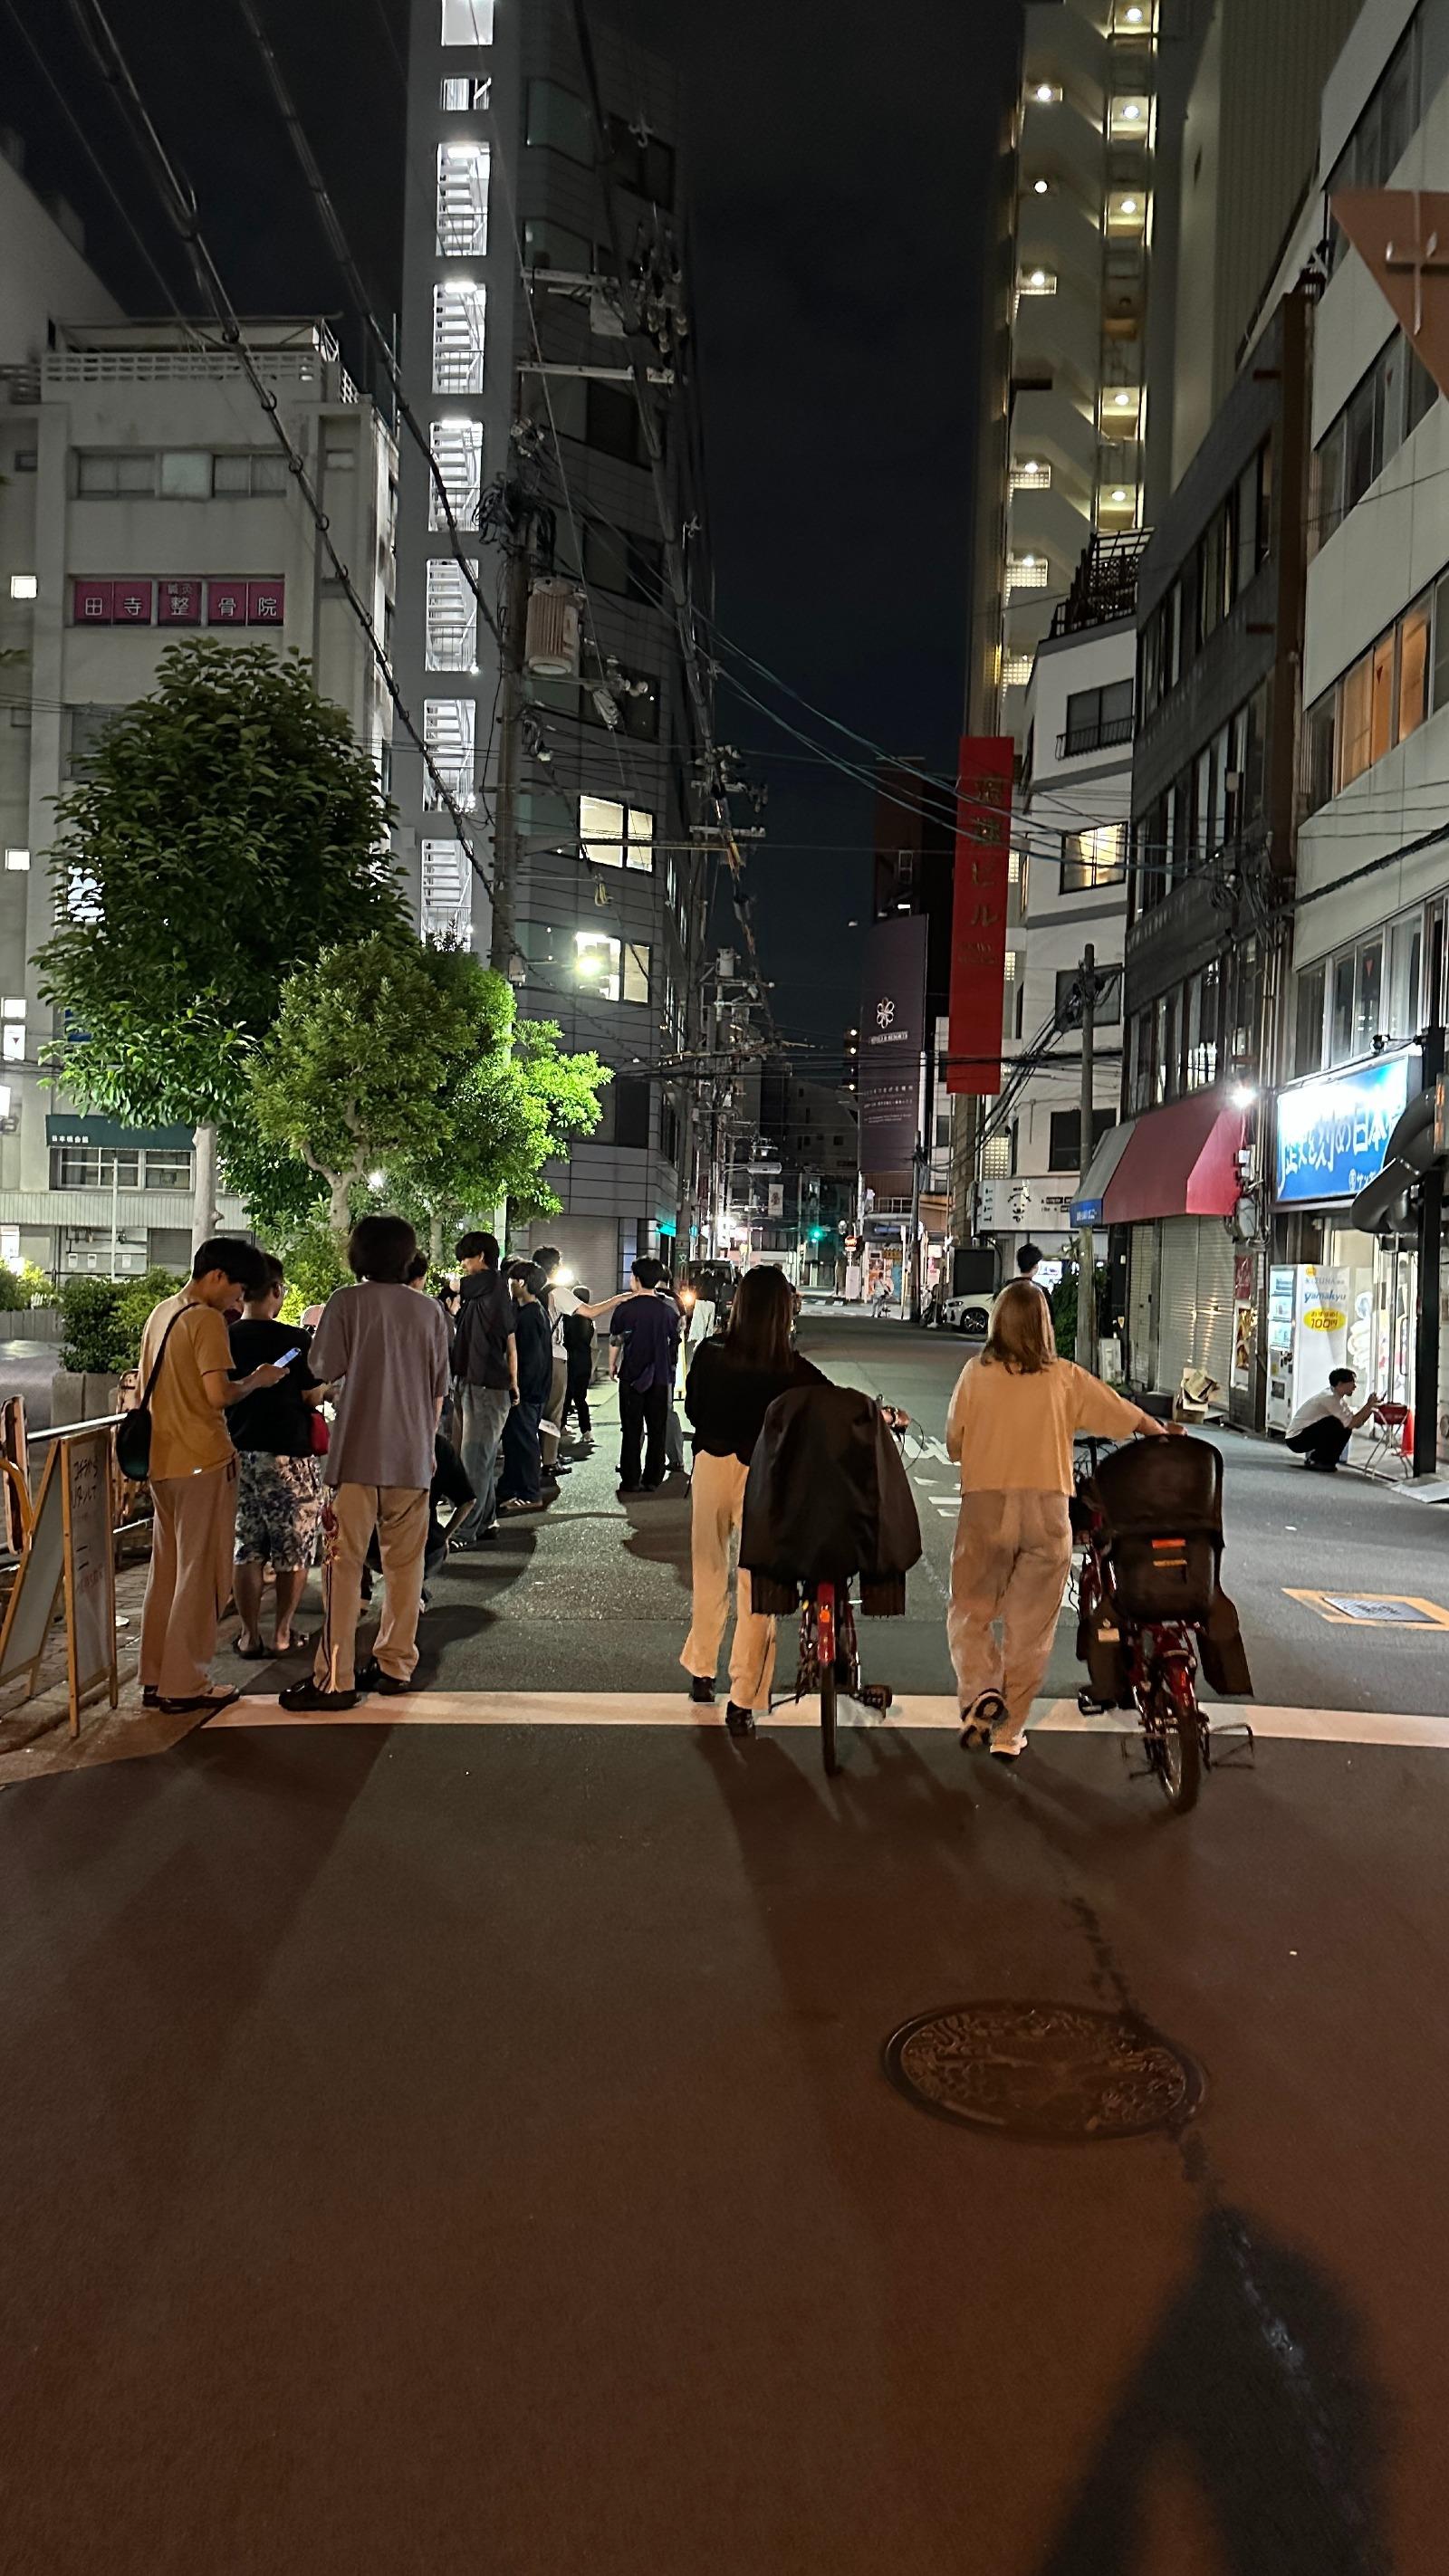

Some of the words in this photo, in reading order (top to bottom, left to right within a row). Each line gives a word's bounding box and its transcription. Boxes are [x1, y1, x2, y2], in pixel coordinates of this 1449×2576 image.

[85, 597, 277, 617] 田寺整骨院
[1304, 1289, 1347, 1303] yamakyu
